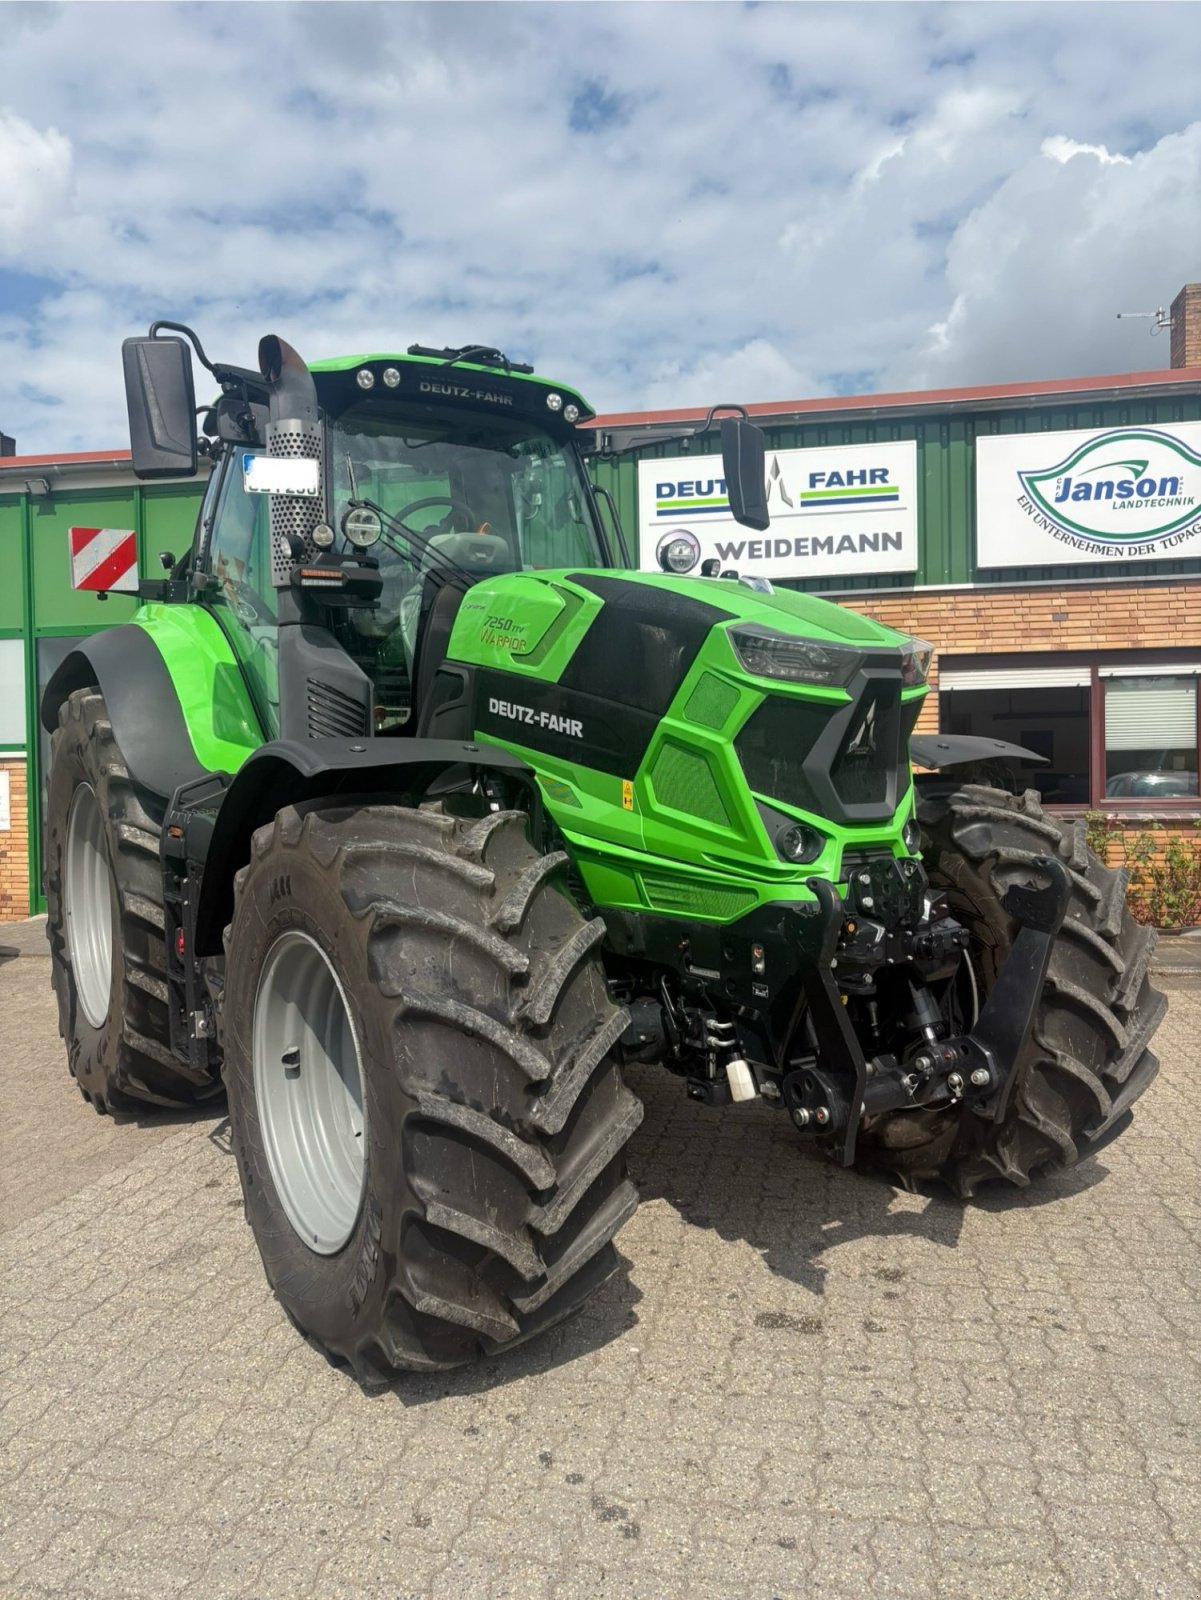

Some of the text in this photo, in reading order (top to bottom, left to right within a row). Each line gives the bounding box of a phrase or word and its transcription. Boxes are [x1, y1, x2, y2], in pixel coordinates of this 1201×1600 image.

[419, 382, 513, 406] DEUTZ-FAHR
[656, 468, 889, 499] DEUT FAHR
[1054, 476, 1180, 503] Janson
[1112, 496, 1195, 510] LANDTECHNIK
[1017, 494, 1035, 516] EIN
[1033, 513, 1124, 557] UNTERNEHMEN
[1128, 543, 1156, 557] DER
[714, 531, 903, 561] WEIDEMANN
[484, 615, 513, 631] 7250
[480, 627, 527, 651] WARRIOR
[488, 698, 584, 738] DEUTZ-FAHR
